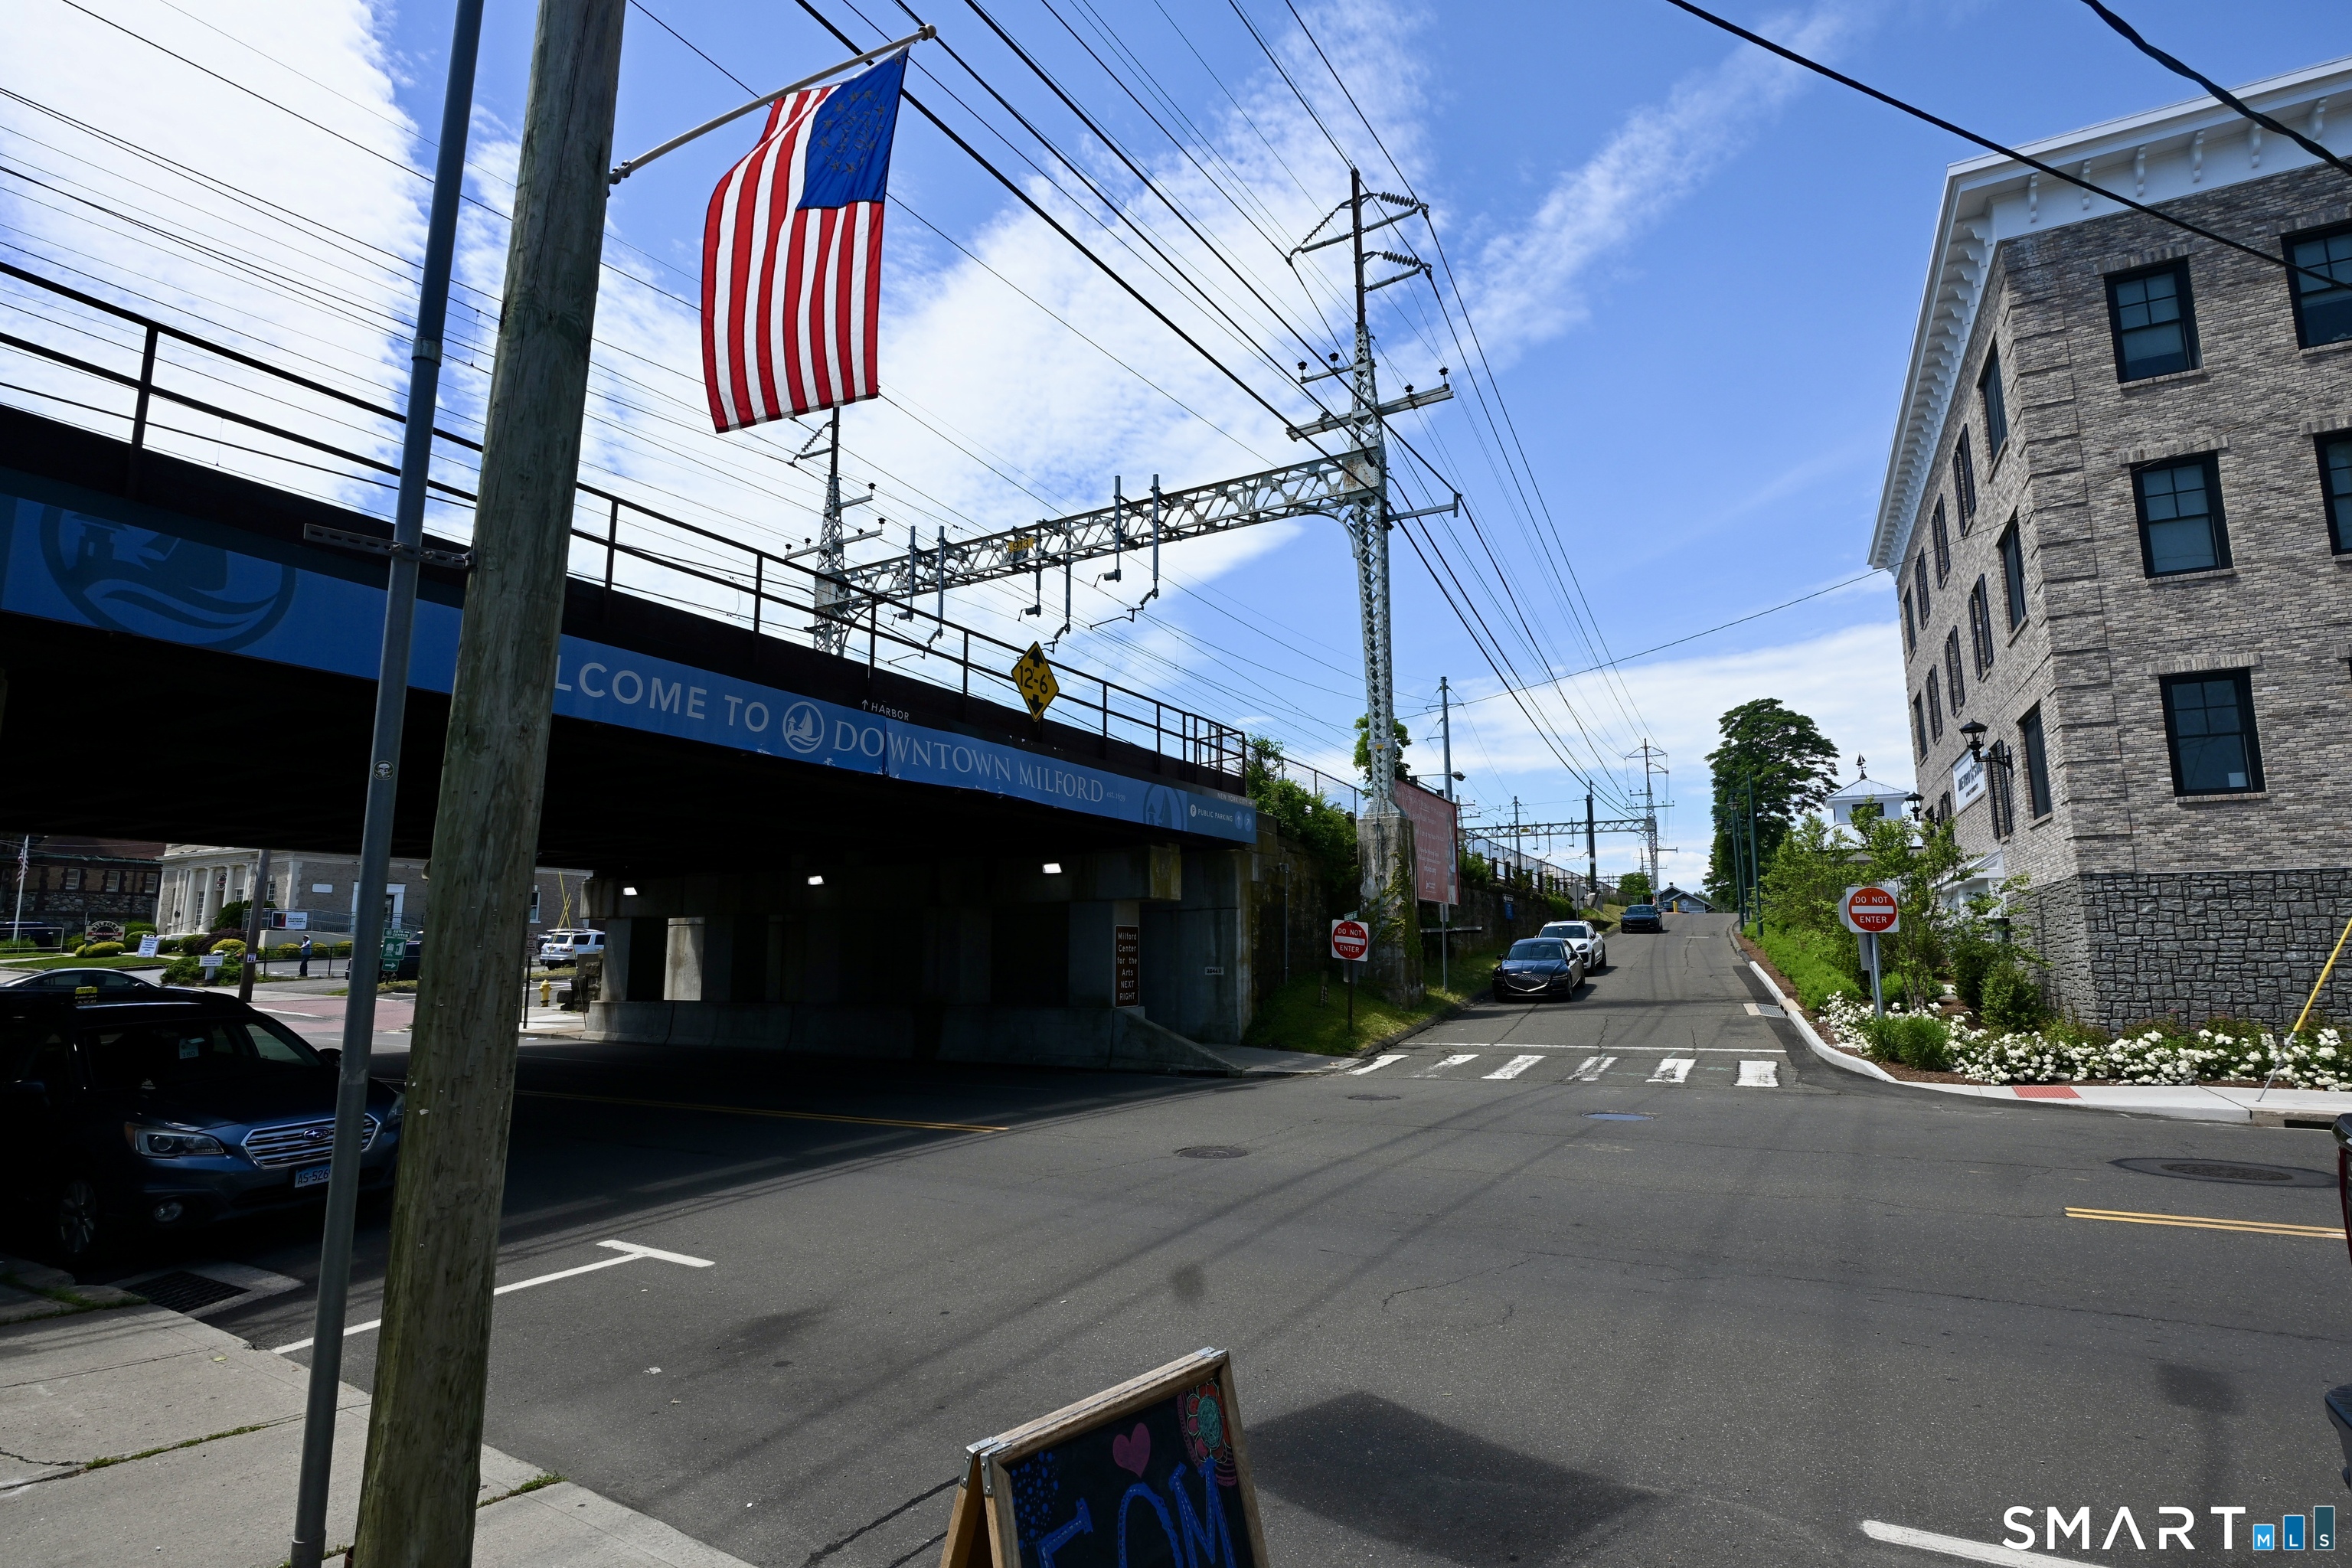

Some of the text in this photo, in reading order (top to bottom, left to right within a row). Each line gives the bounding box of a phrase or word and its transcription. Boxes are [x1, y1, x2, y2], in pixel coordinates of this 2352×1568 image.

[1013, 539, 1029, 550] 913
[871, 702, 910, 721] HARBOR
[554, 655, 707, 720] LCOME
[724, 694, 769, 733] TO
[833, 720, 1011, 782] DOWNTOWN
[1019, 761, 1103, 802] MILFORD
[1116, 792, 1126, 802] 1639
[1197, 808, 1214, 818] PUBLIC
[1214, 812, 1233, 822] PARKING
[91, 921, 119, 933] MILFORD
[1118, 932, 1137, 940] Milford
[1118, 944, 1136, 952] Center
[1340, 945, 1360, 953] ENTER
[1129, 956, 1137, 965] the
[1120, 980, 1135, 988] NEXT
[1119, 992, 1135, 1001] RIGHT
[298, 1168, 331, 1184] AS-526
